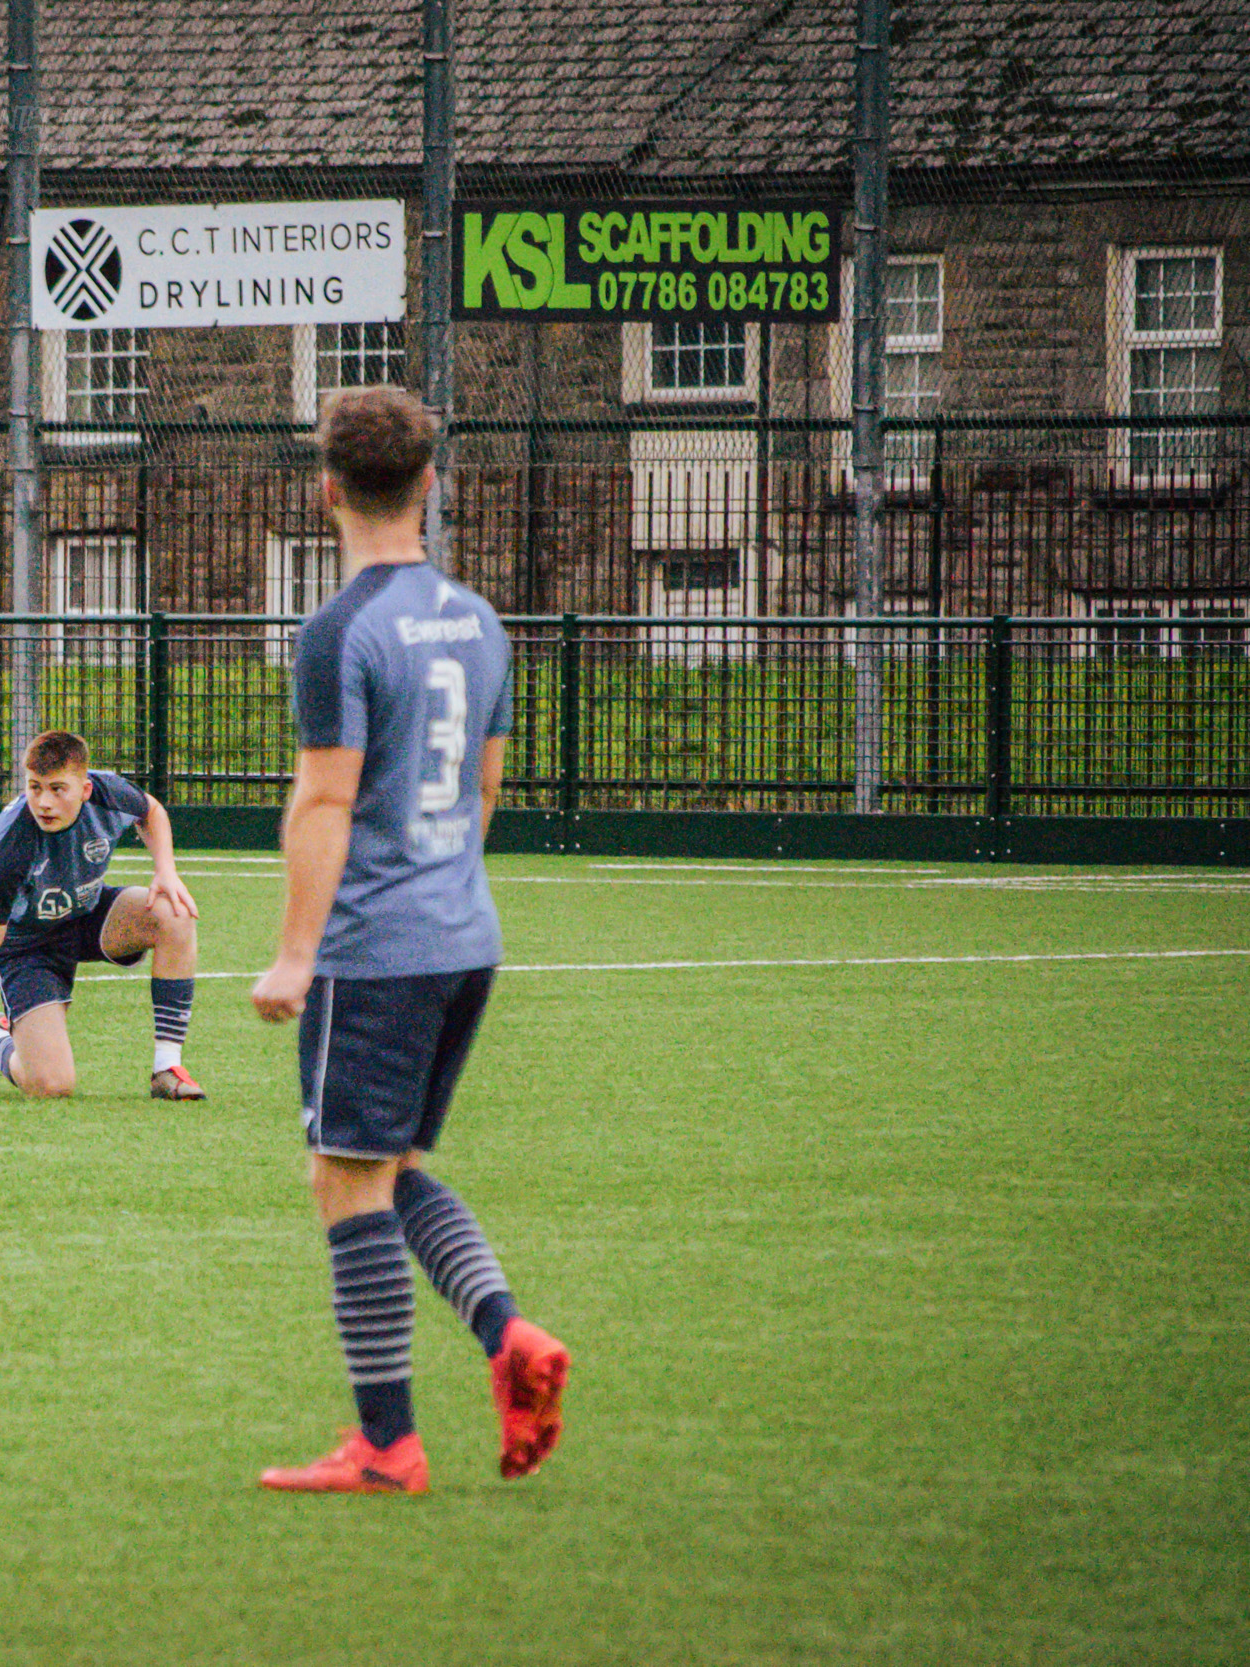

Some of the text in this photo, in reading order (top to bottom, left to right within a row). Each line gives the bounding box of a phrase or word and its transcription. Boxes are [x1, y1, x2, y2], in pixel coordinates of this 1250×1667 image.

[232, 221, 392, 255] INTERIORS
[463, 210, 592, 311] KSL
[578, 211, 830, 264] SCAFFOLDING
[139, 276, 345, 309] DRYLINING
[598, 271, 830, 312] 07786 084783
[419, 657, 468, 813] 3
